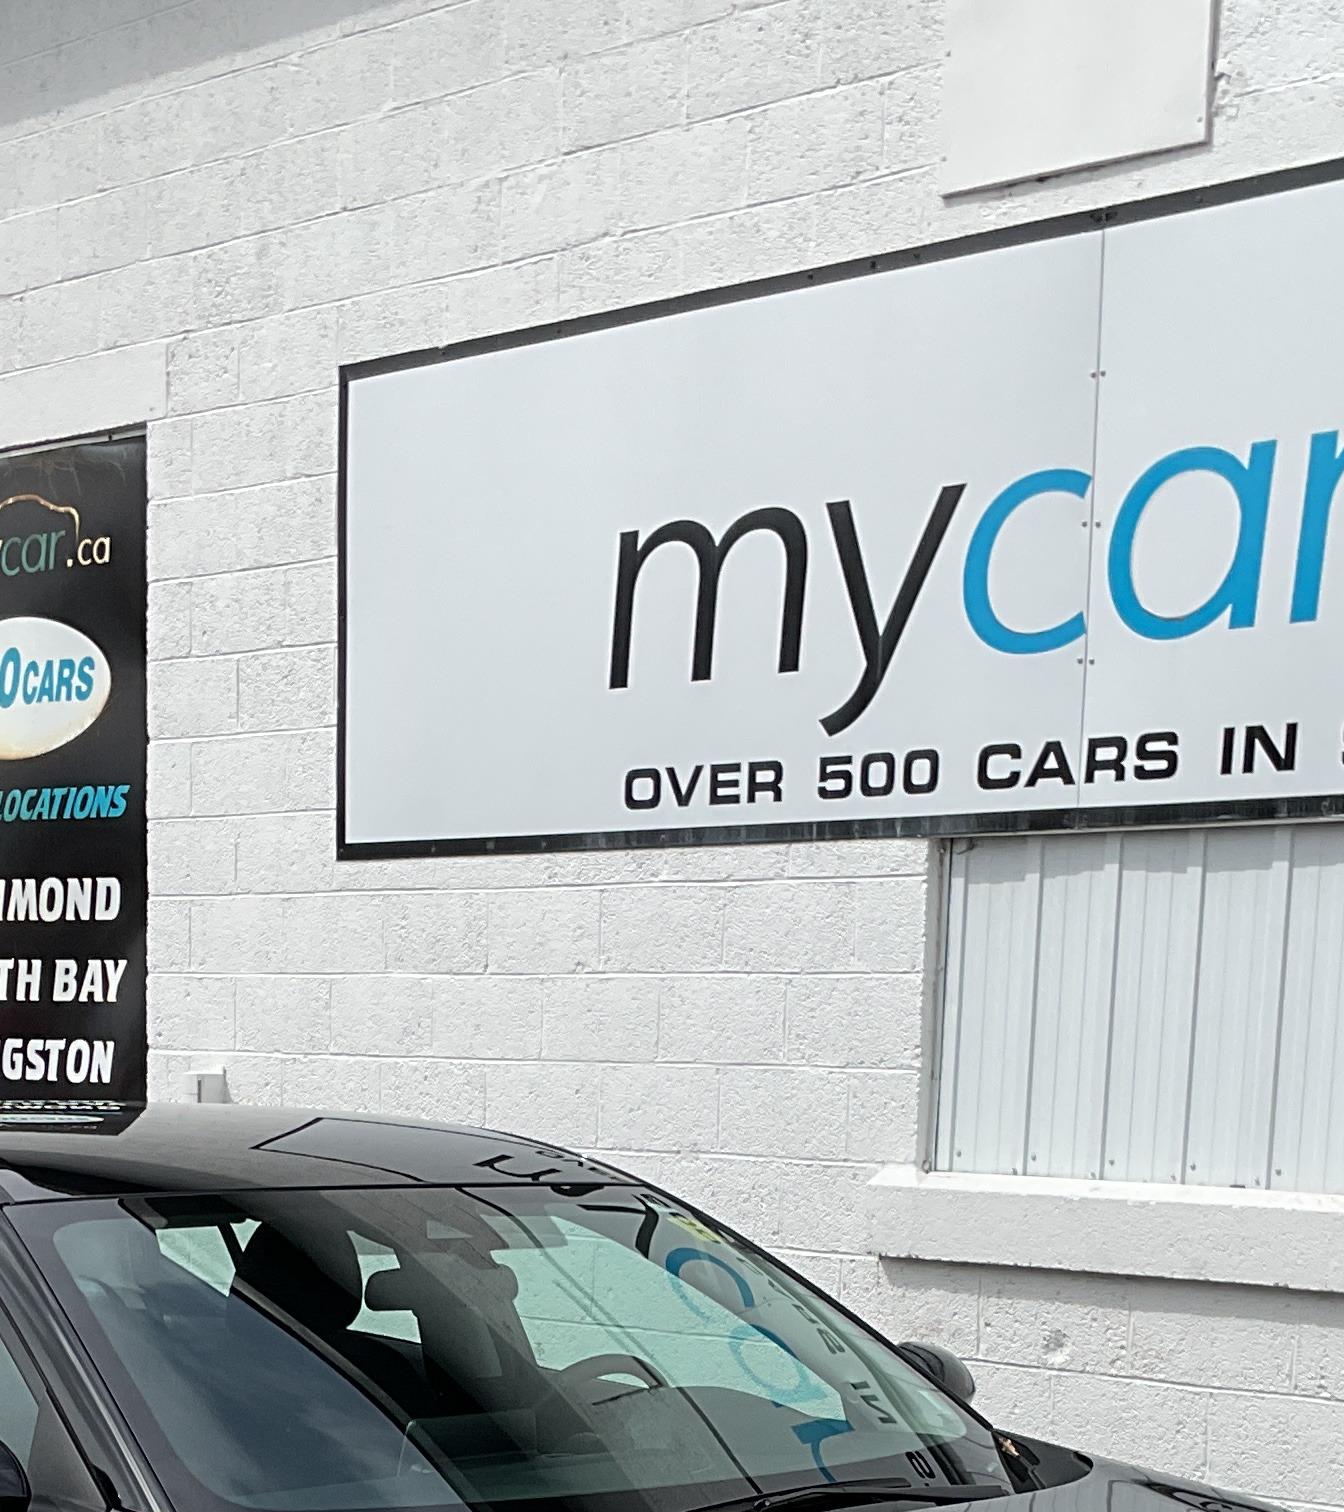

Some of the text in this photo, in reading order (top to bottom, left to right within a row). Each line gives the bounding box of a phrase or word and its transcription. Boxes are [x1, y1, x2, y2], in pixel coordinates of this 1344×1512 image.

[624, 760, 784, 811] OVER
[817, 748, 940, 801] 500
[977, 731, 1179, 791] CARS
[1220, 721, 1299, 776] IN
[52, 959, 128, 1003] BAY
